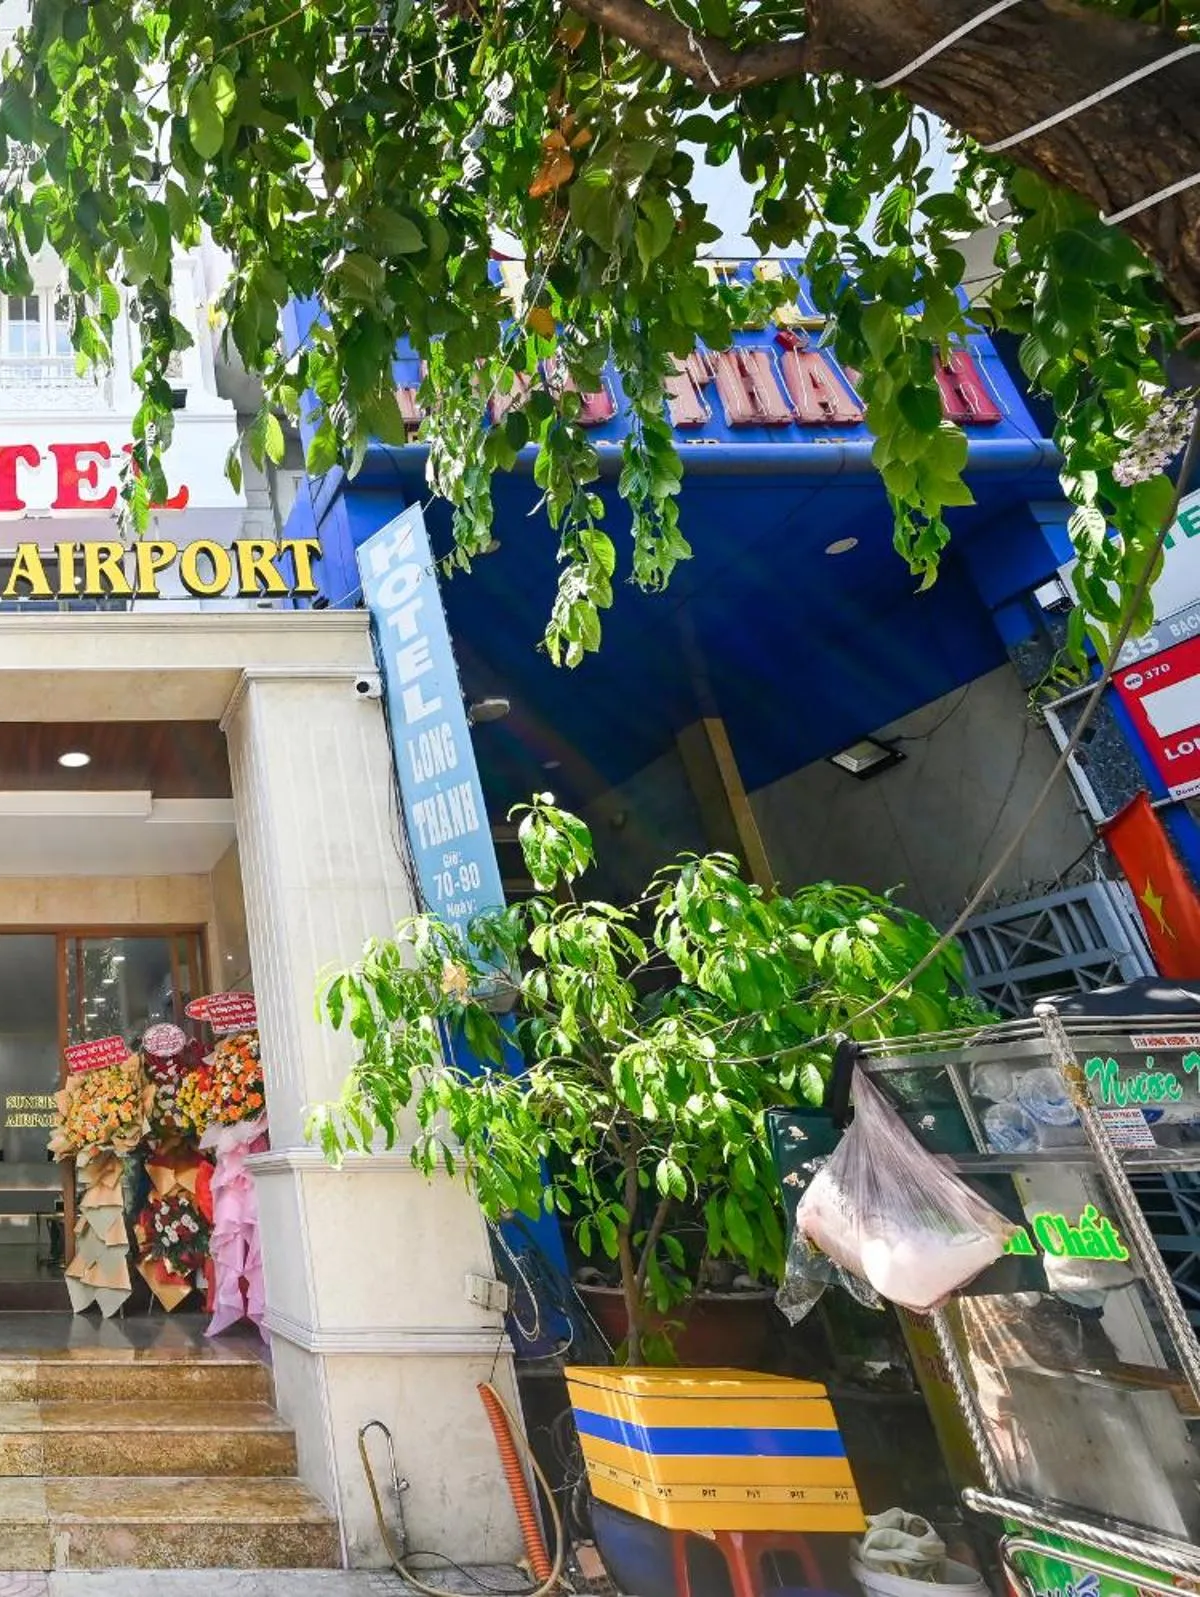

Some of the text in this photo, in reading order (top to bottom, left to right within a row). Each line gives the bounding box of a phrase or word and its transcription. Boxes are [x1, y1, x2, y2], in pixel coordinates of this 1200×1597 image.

[0, 538, 322, 600] AIRPORT
[369, 520, 443, 724] HOTEL
[1144, 663, 1170, 680] 370
[407, 721, 459, 784] LONG
[6, 1094, 57, 1109] SUNRIS
[1032, 1202, 1130, 1262] Chất
